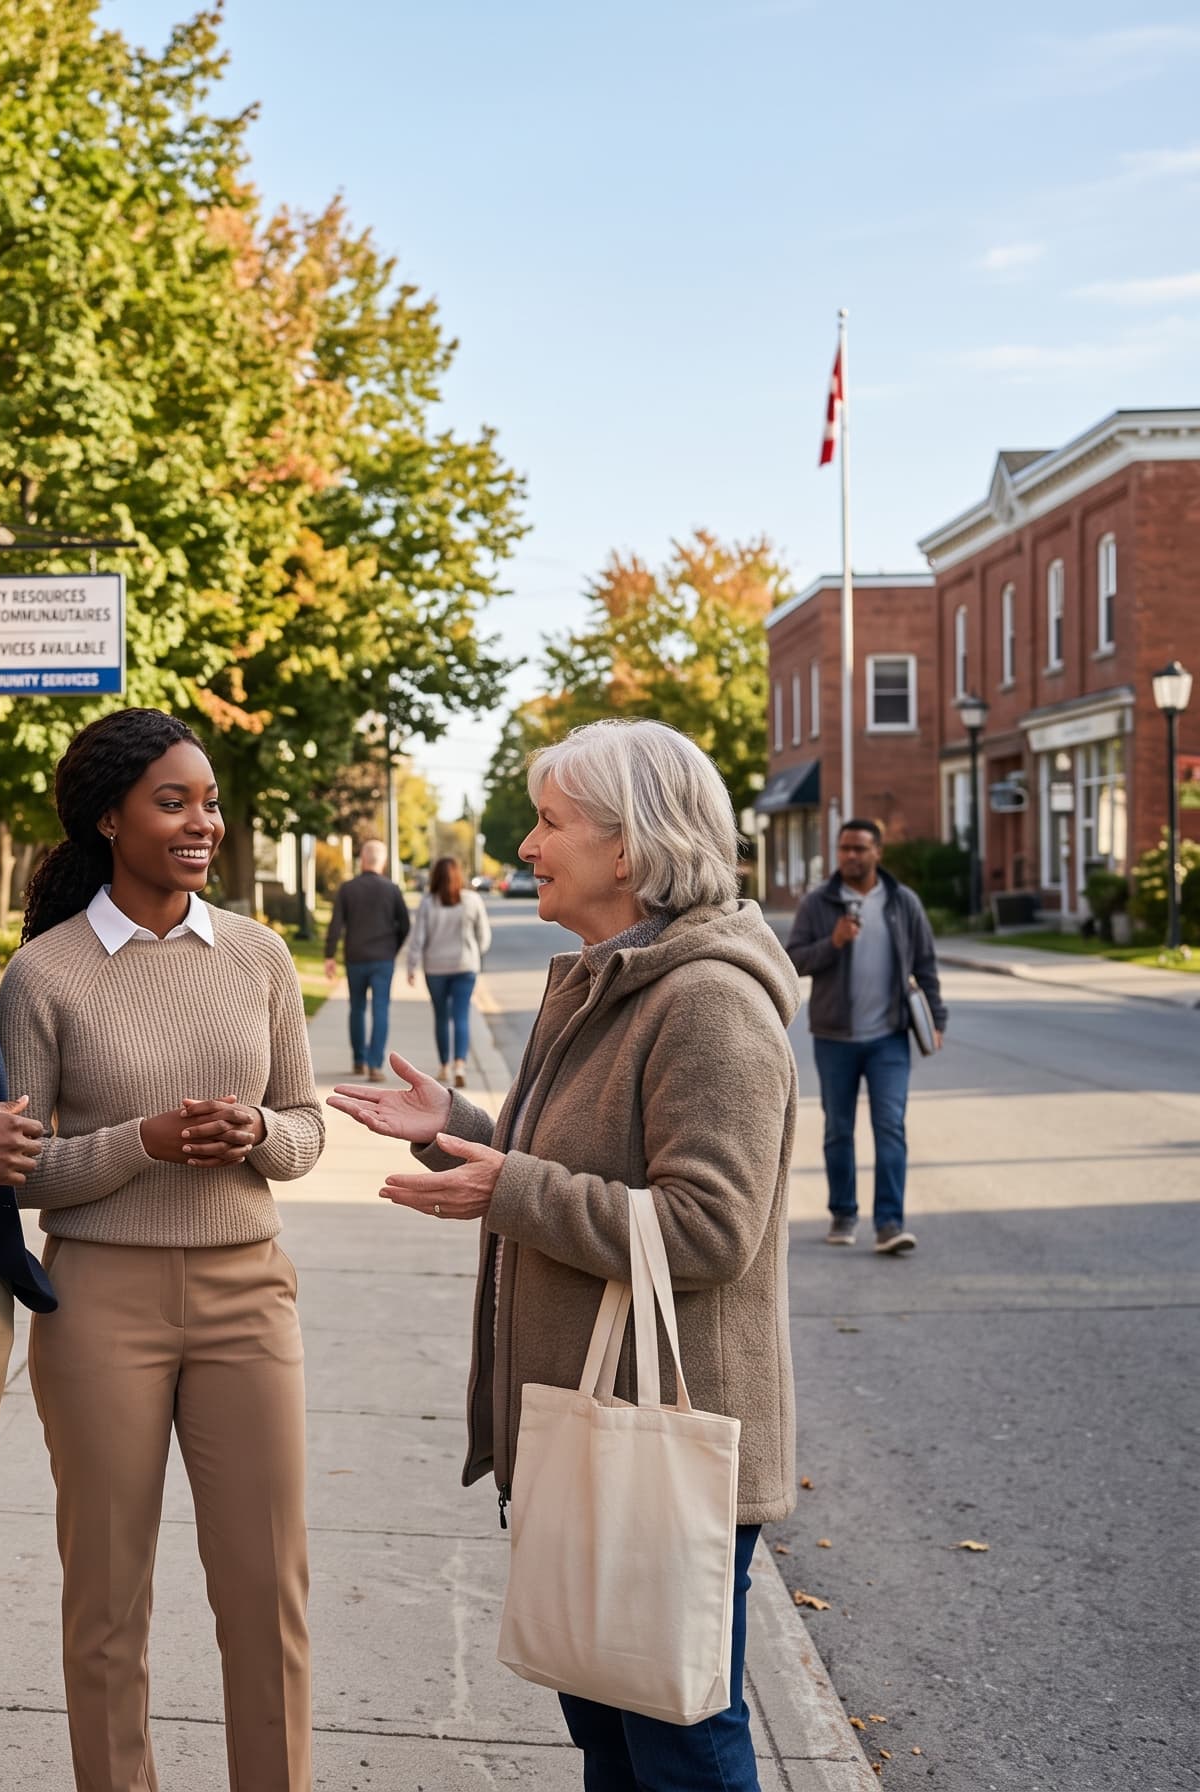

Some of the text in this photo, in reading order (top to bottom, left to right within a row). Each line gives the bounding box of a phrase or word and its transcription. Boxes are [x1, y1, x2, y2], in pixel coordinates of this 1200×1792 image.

[12, 588, 87, 604] RESOURCES
[39, 640, 106, 656] AVAILABLE
[41, 672, 99, 687] SERVICES
